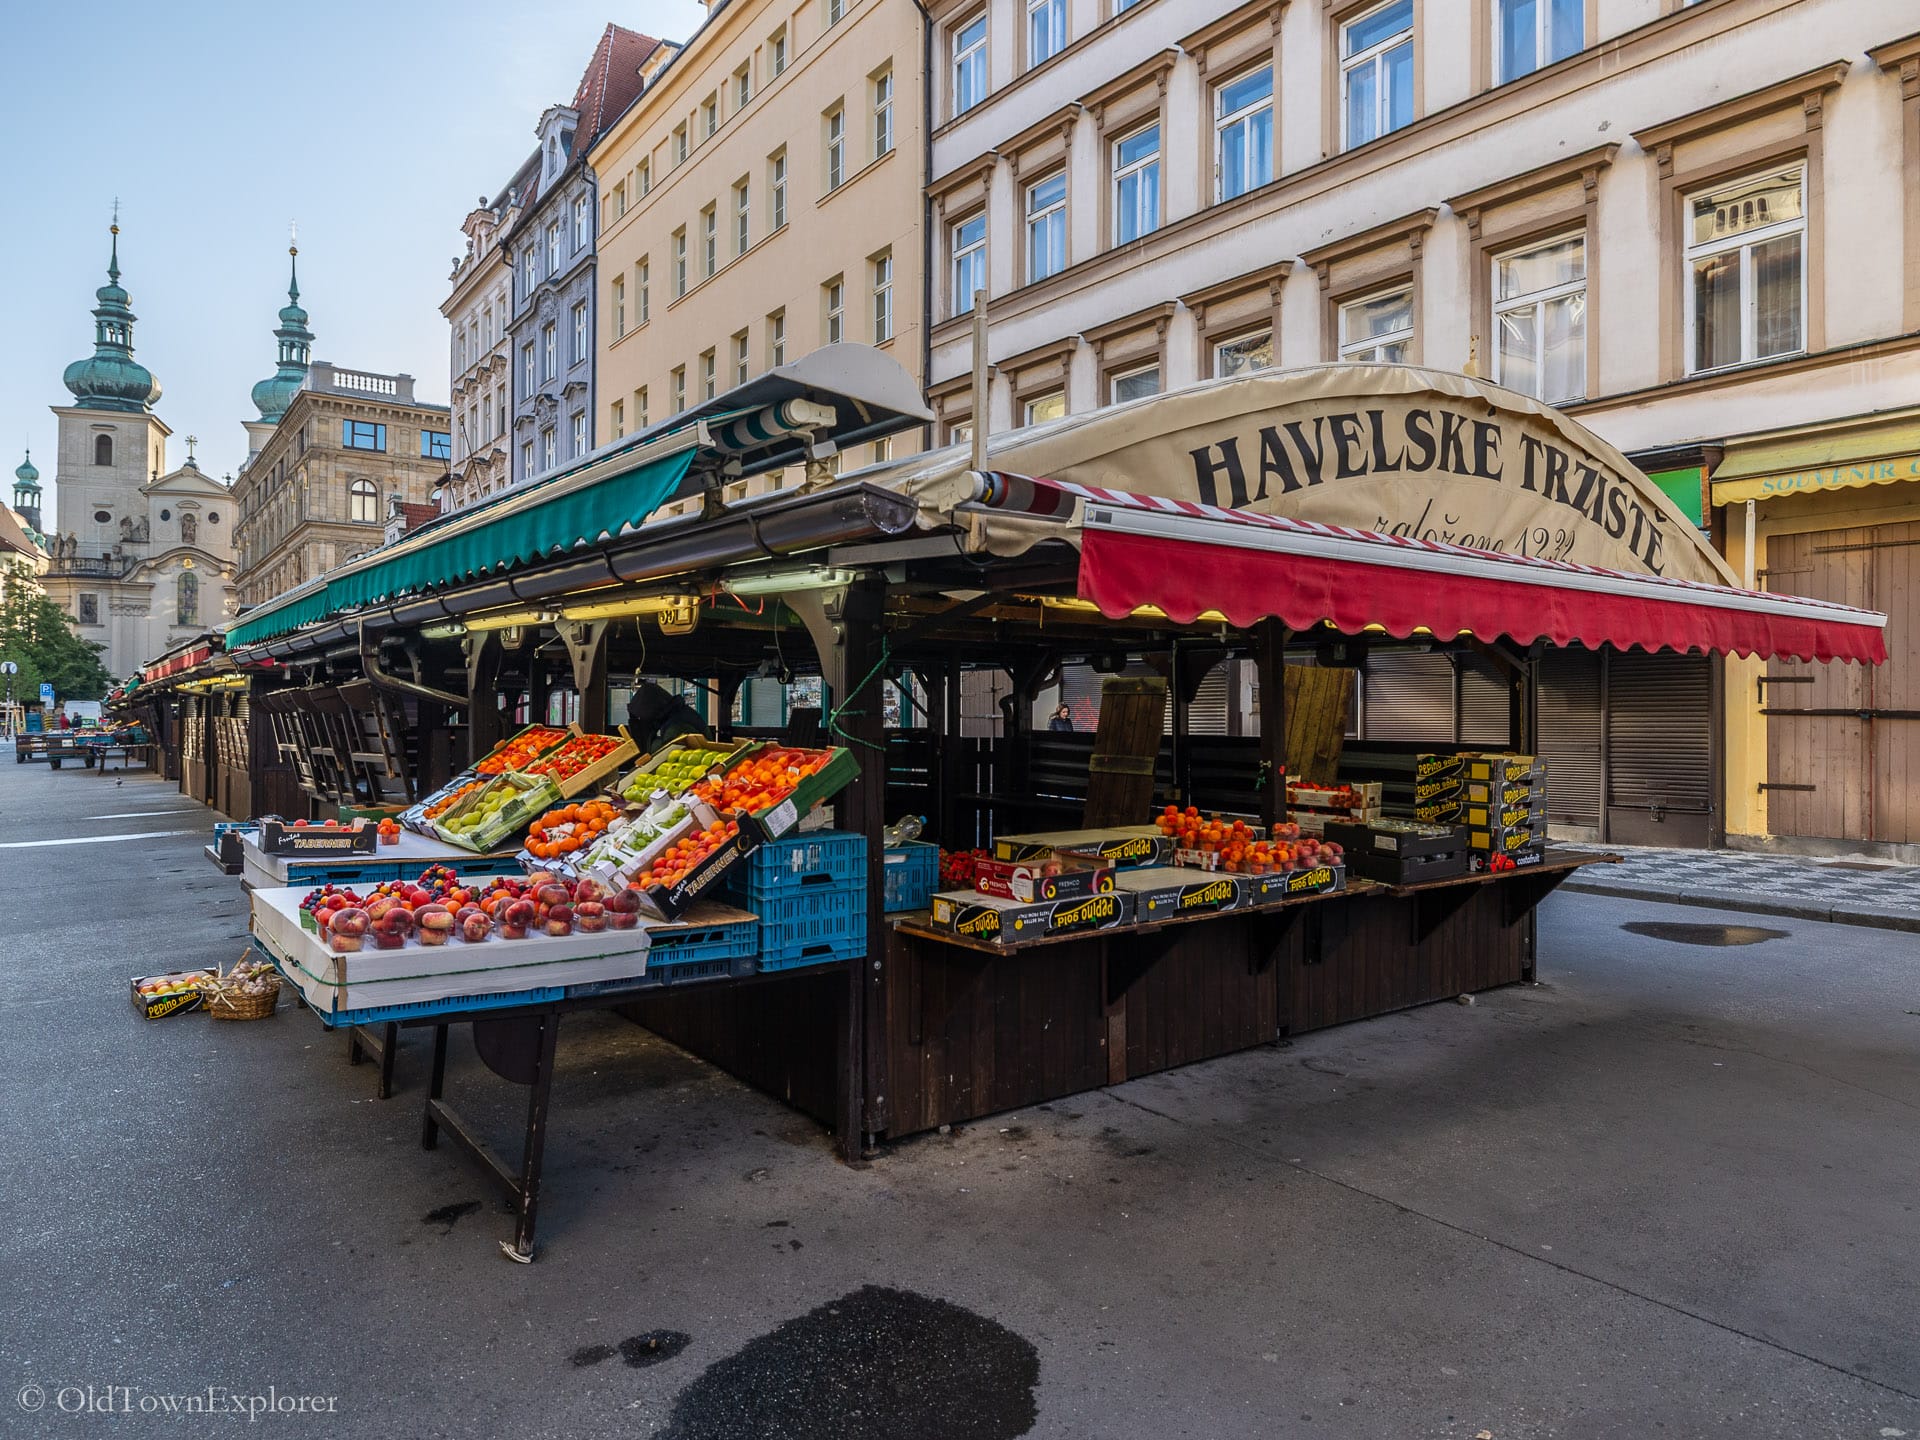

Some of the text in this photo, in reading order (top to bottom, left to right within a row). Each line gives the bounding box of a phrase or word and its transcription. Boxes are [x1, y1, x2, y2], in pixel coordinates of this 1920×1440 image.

[1189, 405, 1503, 509] HAVELSKÉ
[1761, 463, 1897, 494] SOUVENIR
[293, 839, 352, 849] TABERNER
[685, 846, 740, 897] TABERNER
[1205, 883, 1232, 901] pepino
[1057, 898, 1113, 927] pepino gold
[148, 991, 197, 1017] pepino gold
